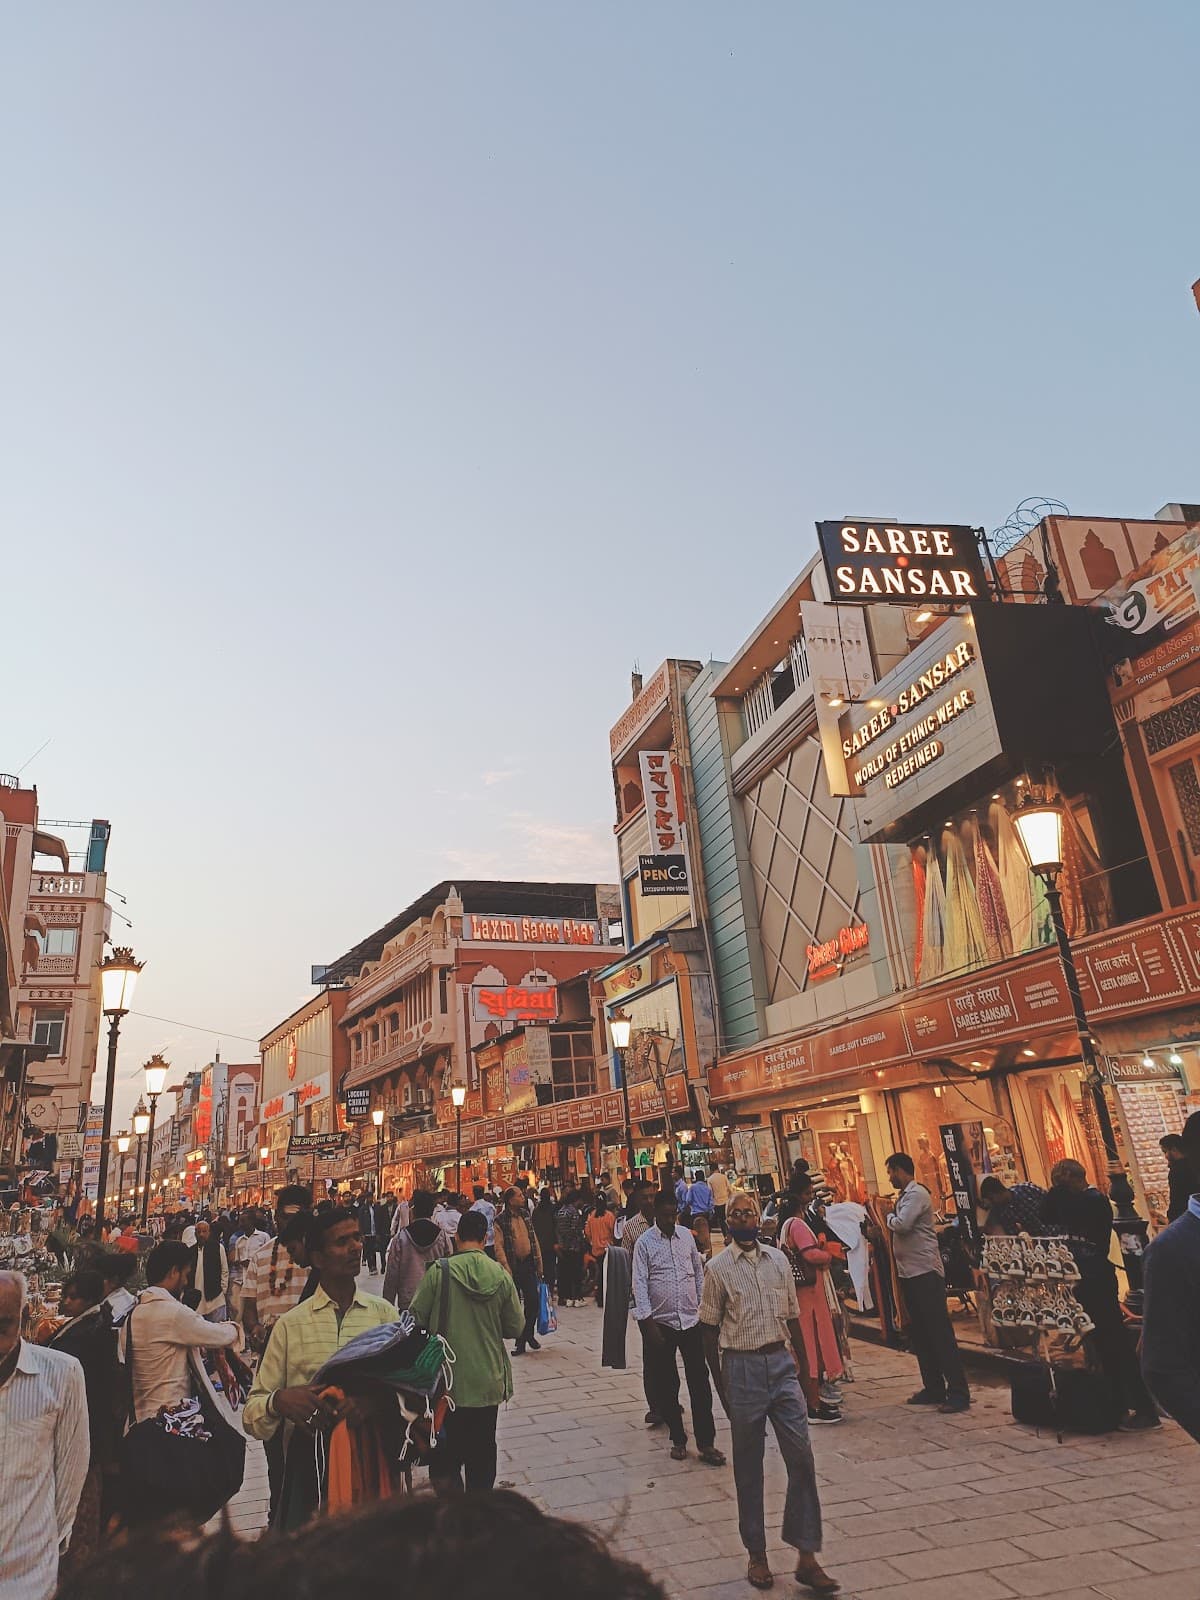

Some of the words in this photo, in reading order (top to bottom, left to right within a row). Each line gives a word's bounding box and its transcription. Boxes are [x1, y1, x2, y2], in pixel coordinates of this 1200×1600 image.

[840, 526, 954, 557] SAREE
[836, 566, 978, 598] SANSAR
[1146, 555, 1200, 609] TATT
[1156, 645, 1167, 661] &
[1167, 631, 1194, 654] Nose
[1135, 669, 1157, 686] Tattoo
[1157, 651, 1190, 674] Removing
[843, 706, 893, 759] SAREE
[899, 642, 974, 714] SANSAR
[854, 755, 885, 786] WORLD
[886, 741, 900, 763] OF
[900, 715, 937, 752] ETHNIC
[936, 689, 972, 725] WEAR
[885, 741, 940, 788] REDEFINED
[471, 914, 519, 941] Laxmi
[1100, 977, 1118, 992] GEETA
[1117, 971, 1141, 987] CORNER
[954, 991, 975, 1012] साड़ी
[977, 986, 1004, 1005] संसार
[955, 1011, 980, 1029] SAREE
[981, 1004, 1012, 1024] SANSAR
[859, 1031, 886, 1047] LEHENGA
[765, 1061, 786, 1076] SAREE
[786, 1056, 805, 1072] GHAR
[1111, 1061, 1145, 1077] SAREE
